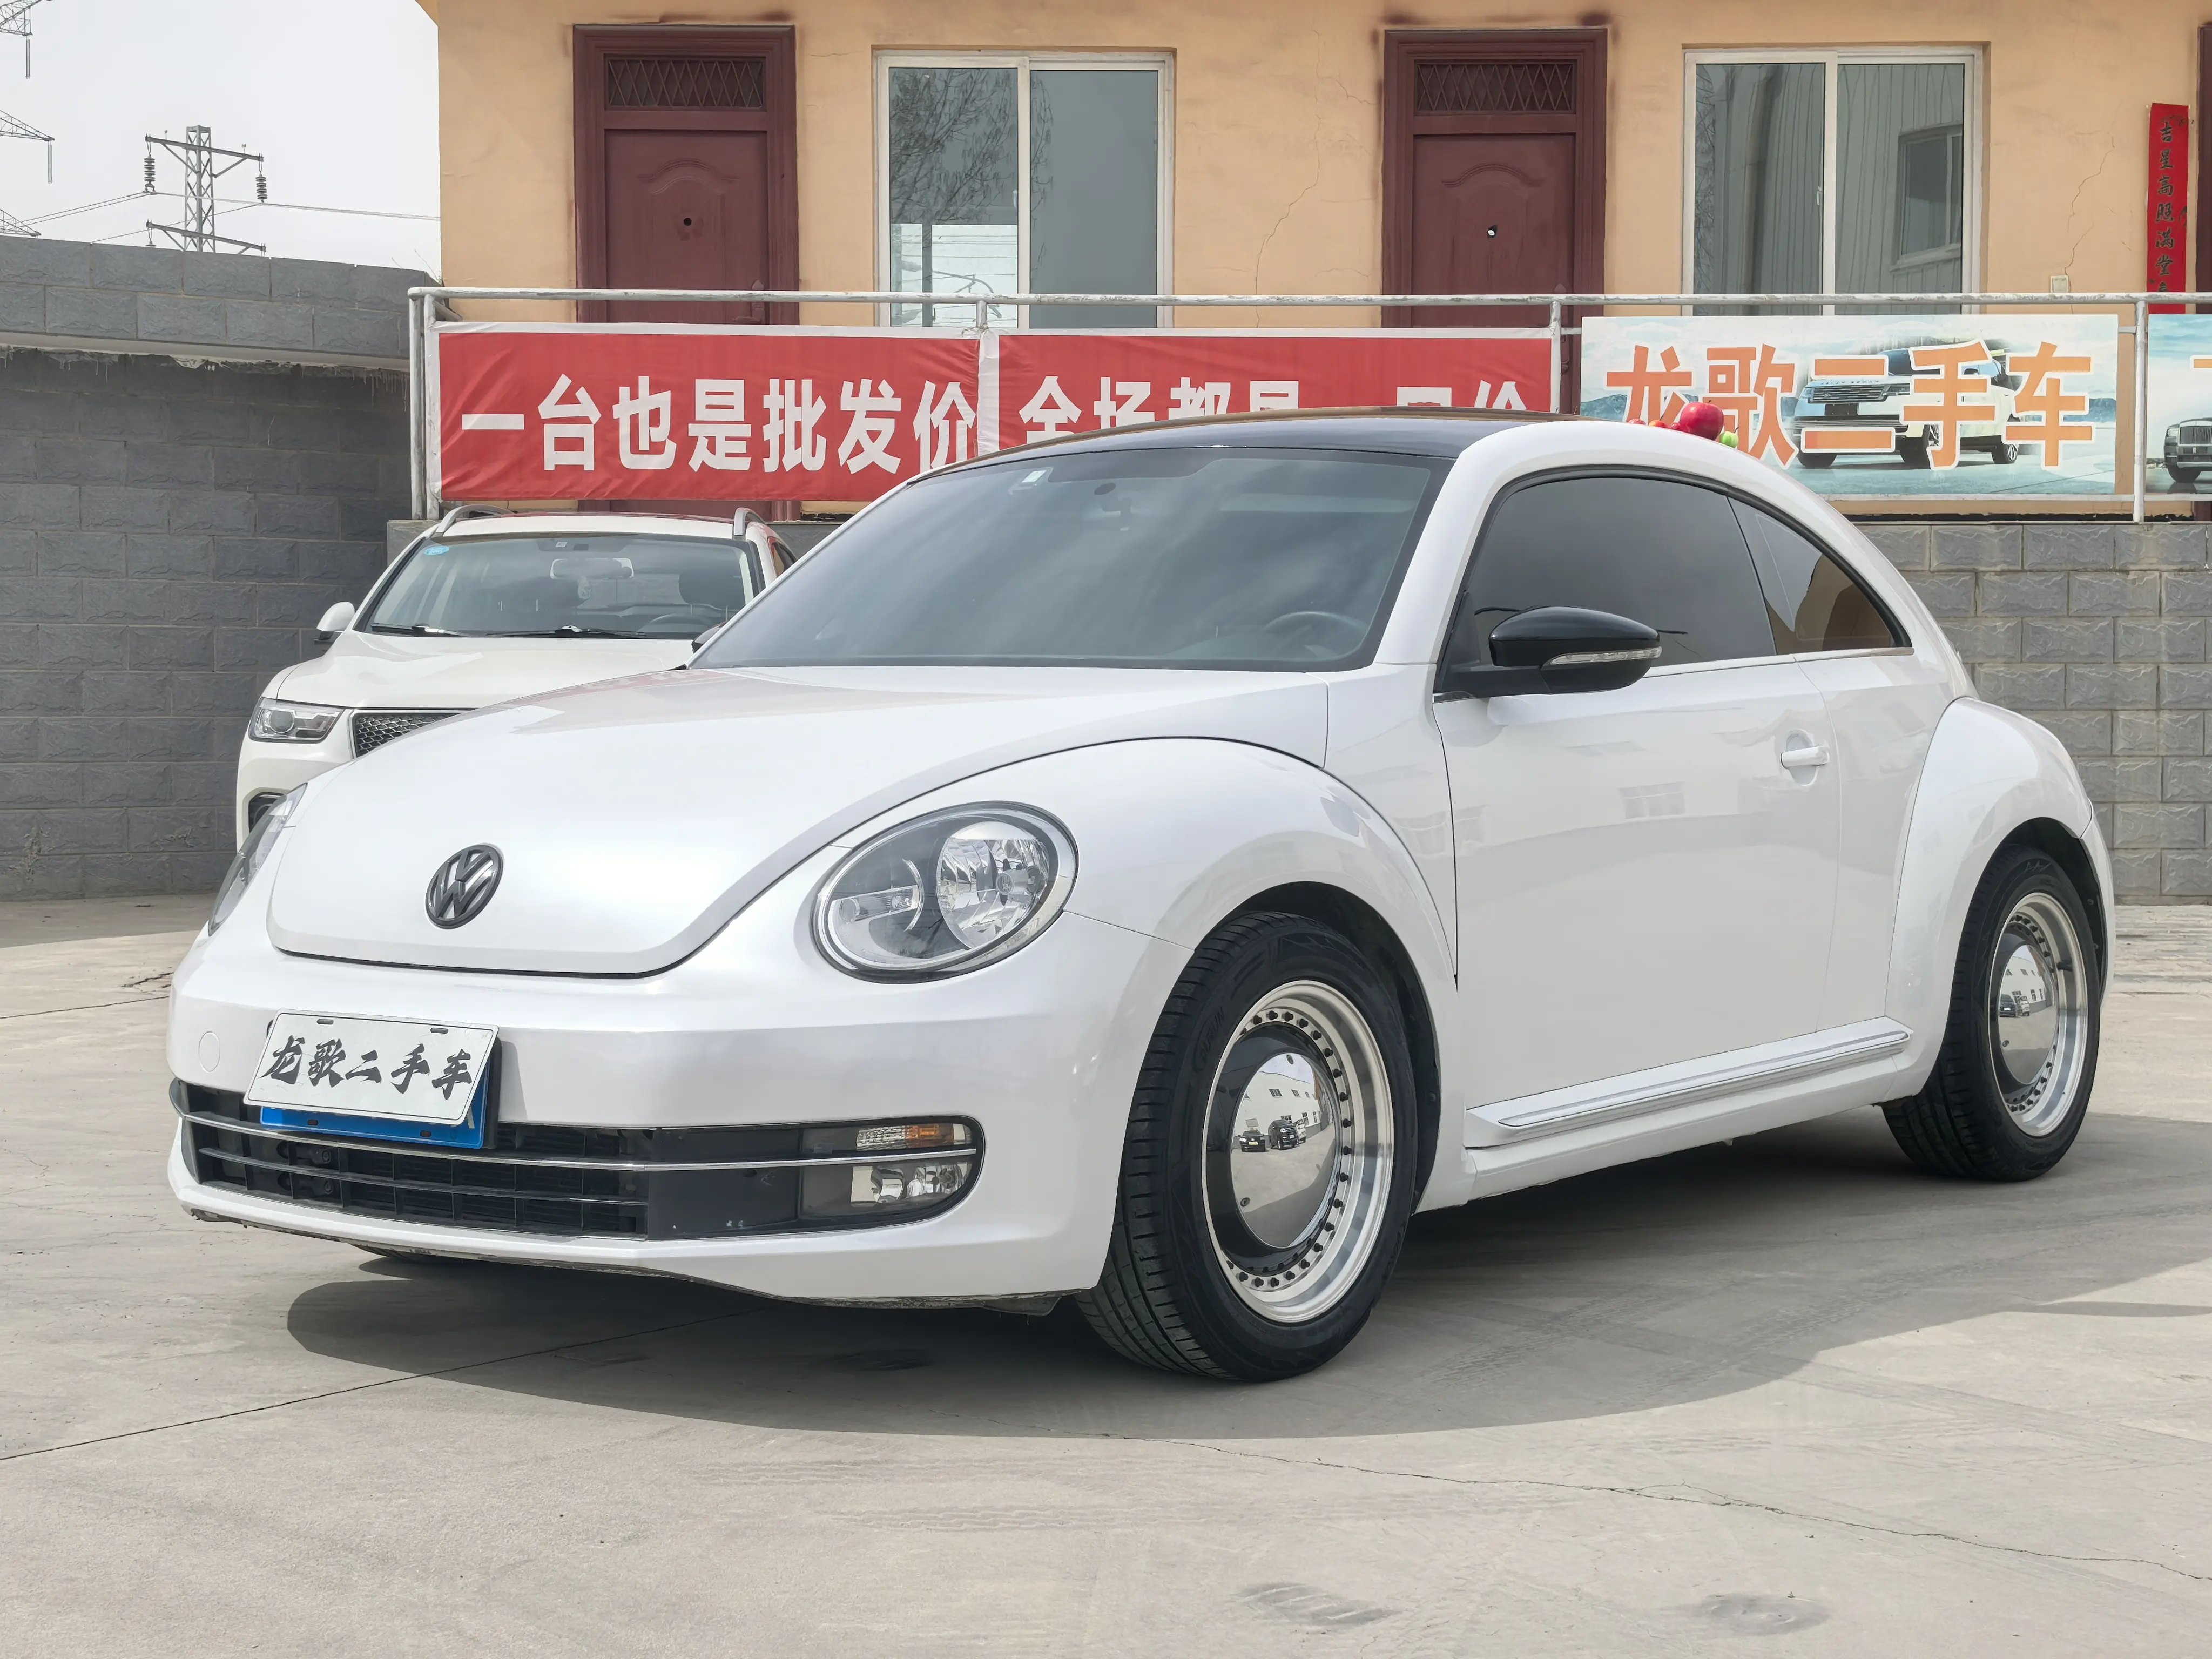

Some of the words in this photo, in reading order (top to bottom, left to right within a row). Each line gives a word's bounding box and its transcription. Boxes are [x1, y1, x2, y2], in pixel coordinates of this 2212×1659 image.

[462, 374, 975, 473] 一台也是批发价
[1607, 340, 2092, 468] 龙歌二手车
[260, 1035, 473, 1100] 龙歌二手车
